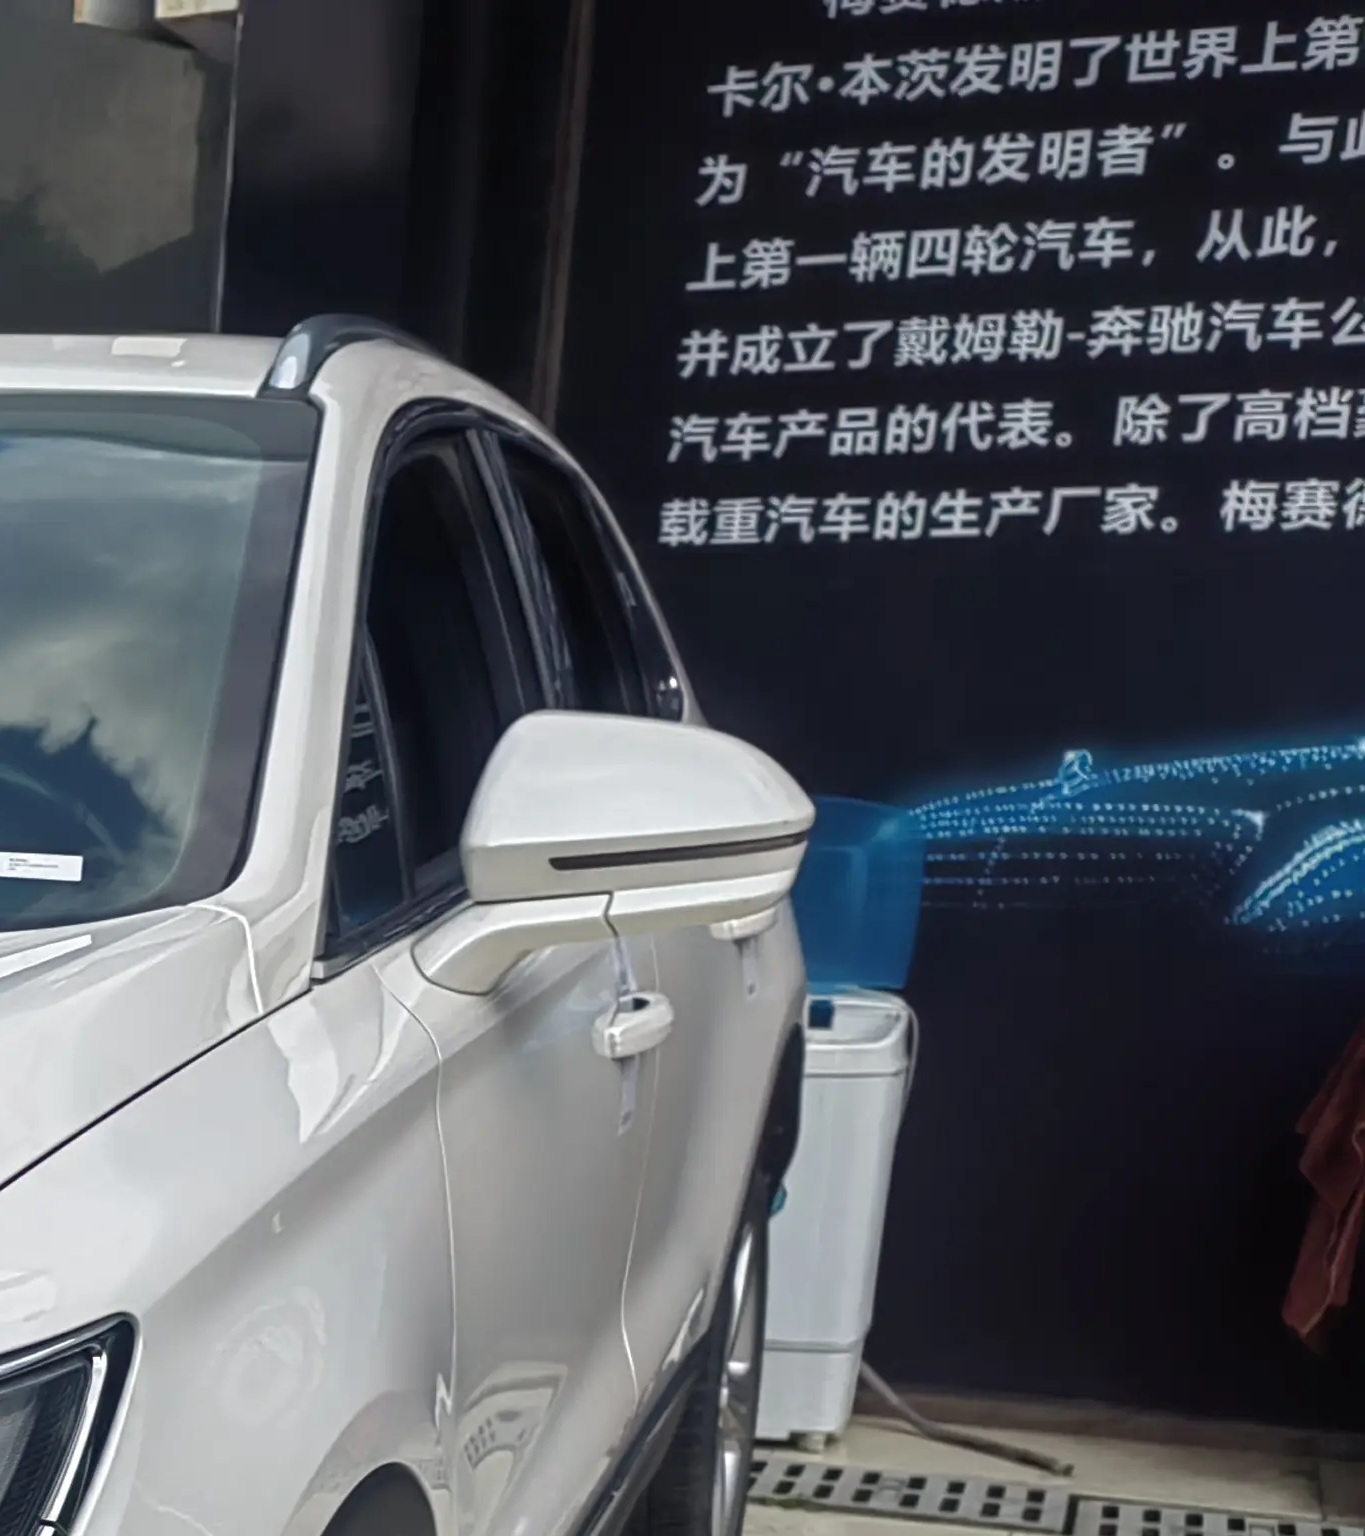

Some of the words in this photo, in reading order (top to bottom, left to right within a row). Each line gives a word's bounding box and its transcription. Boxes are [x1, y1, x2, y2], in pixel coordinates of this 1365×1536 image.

[667, 386, 1365, 463] 汽车产品的代表。除了高档
